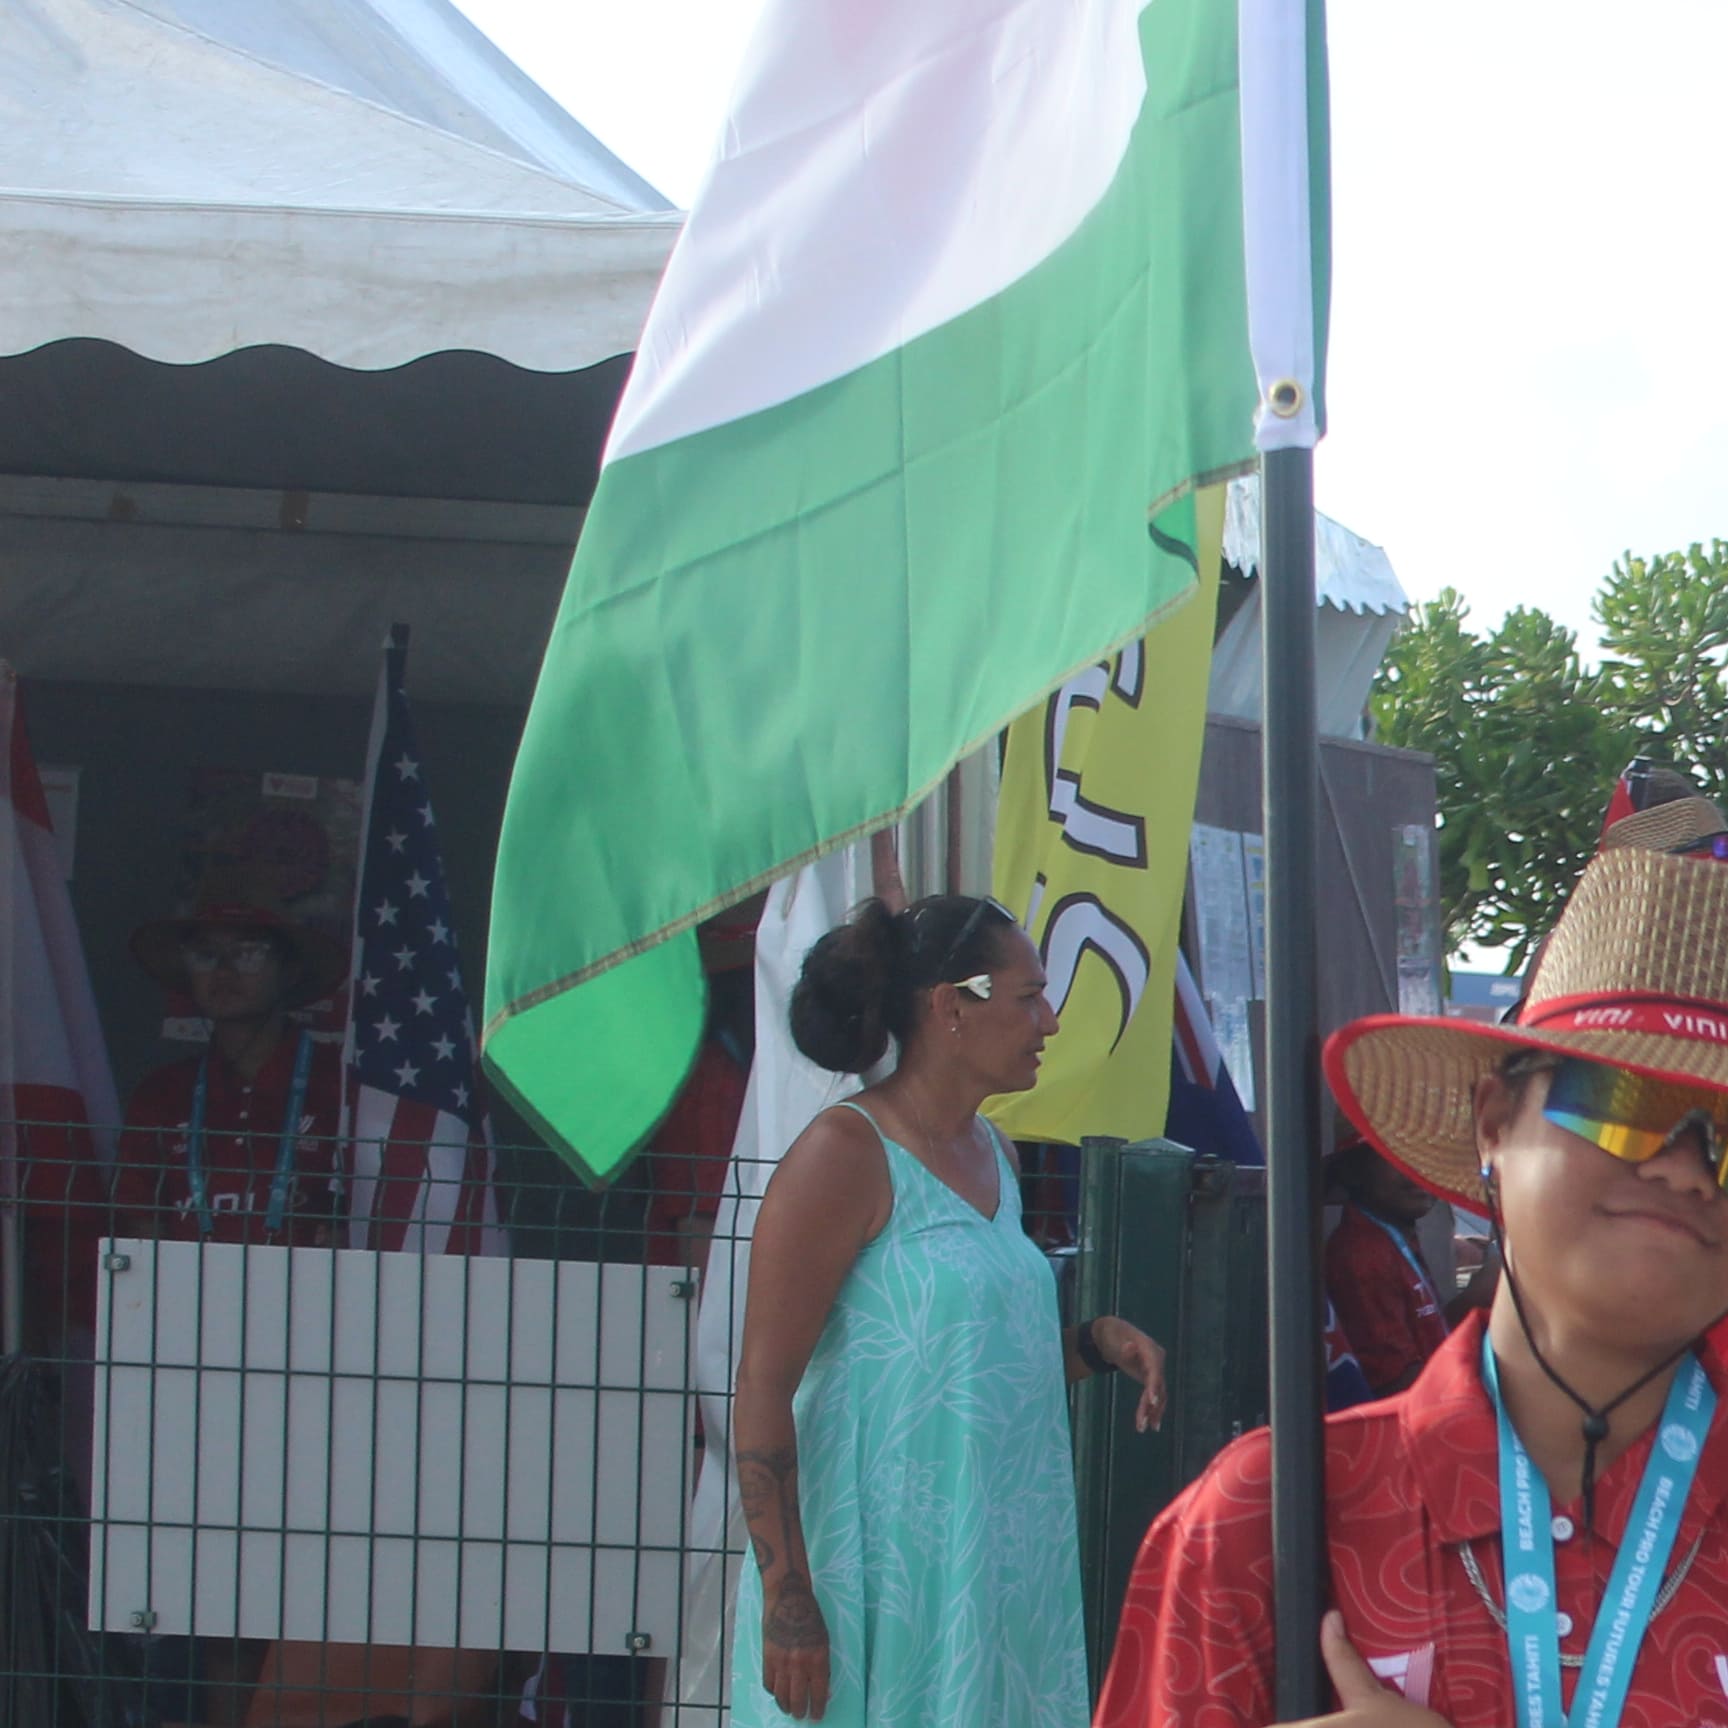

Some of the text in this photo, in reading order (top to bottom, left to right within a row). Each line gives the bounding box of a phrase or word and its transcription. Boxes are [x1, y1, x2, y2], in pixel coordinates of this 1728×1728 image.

[1646, 1476, 1674, 1530] BEACH
[1636, 1528, 1657, 1564] PRO
[1621, 1565, 1646, 1609] TOUR
[1524, 1635, 1541, 1692] TAHITI
[1596, 1608, 1632, 1688] FUTURES
